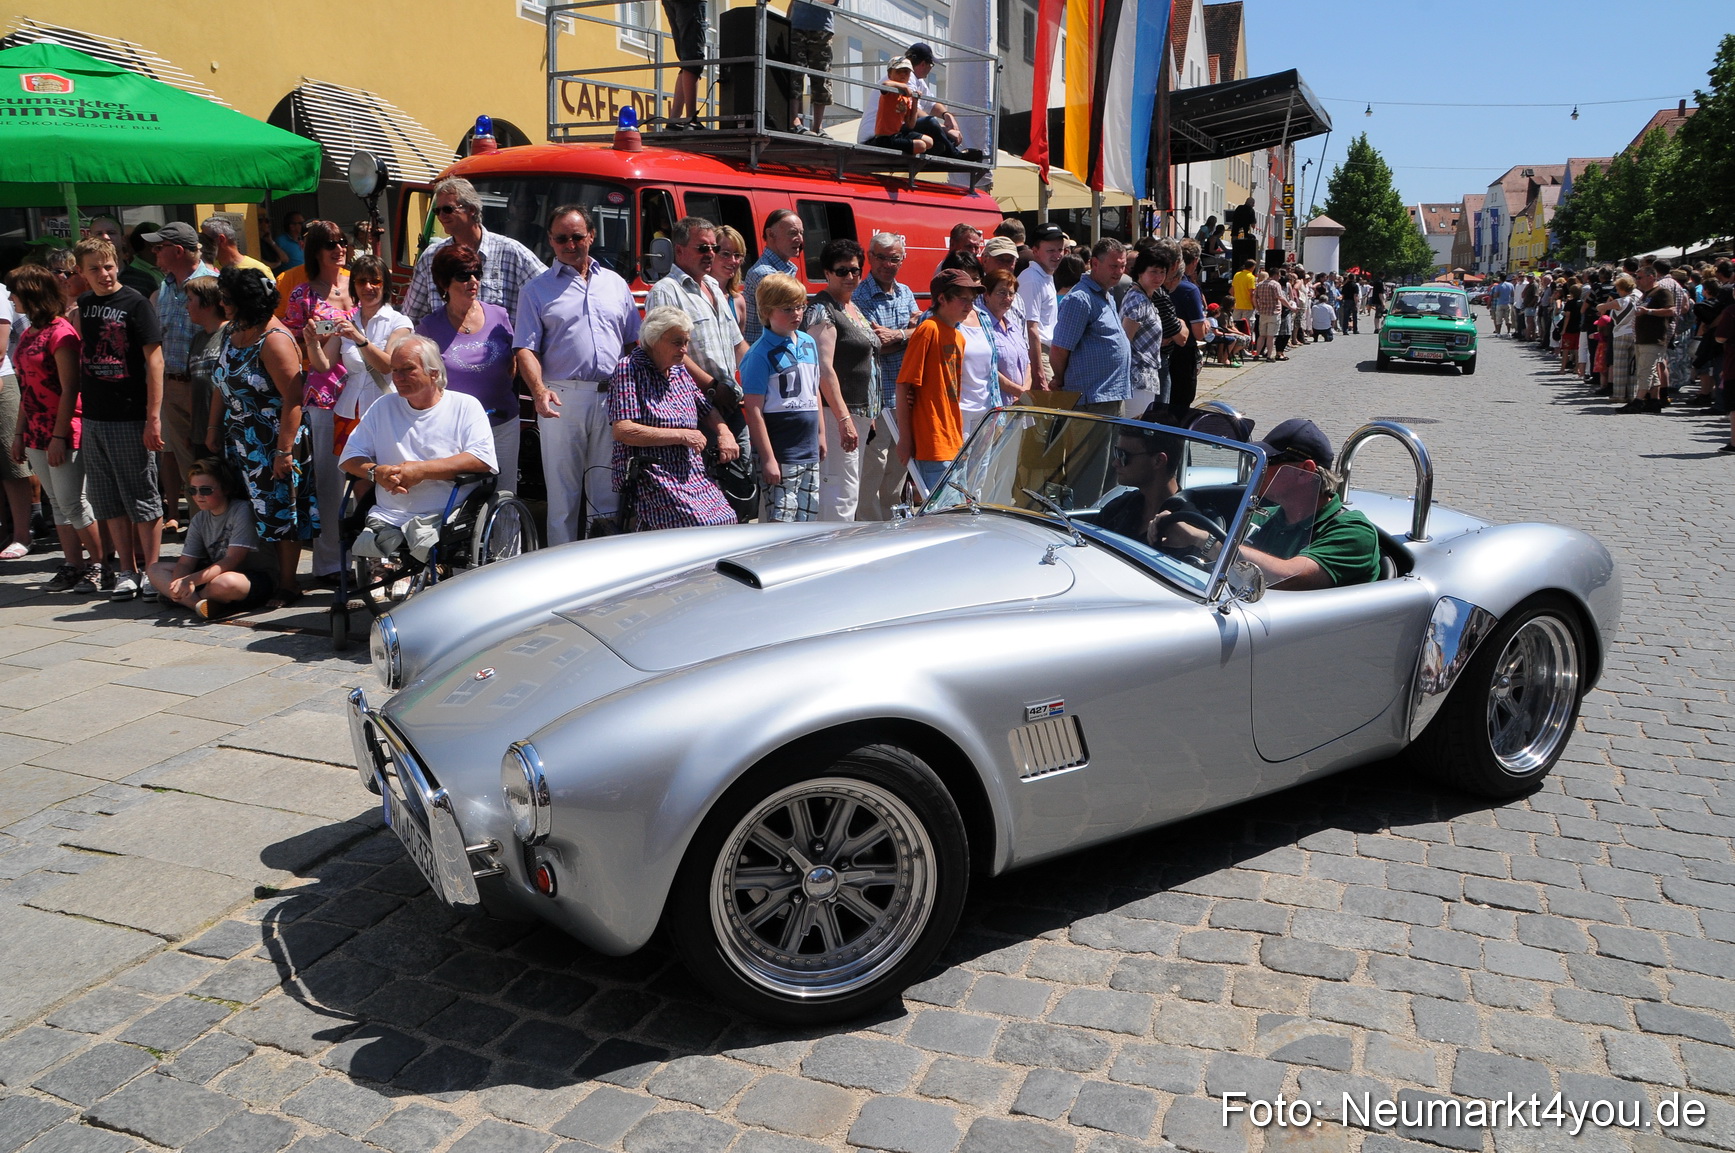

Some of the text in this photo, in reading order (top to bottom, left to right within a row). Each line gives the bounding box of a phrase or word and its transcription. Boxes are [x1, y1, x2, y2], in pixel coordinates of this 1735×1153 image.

[1284, 185, 1294, 239] HOTEL
[1029, 705, 1048, 715] 427
[406, 816, 417, 858] AC
[417, 833, 435, 884] 333
